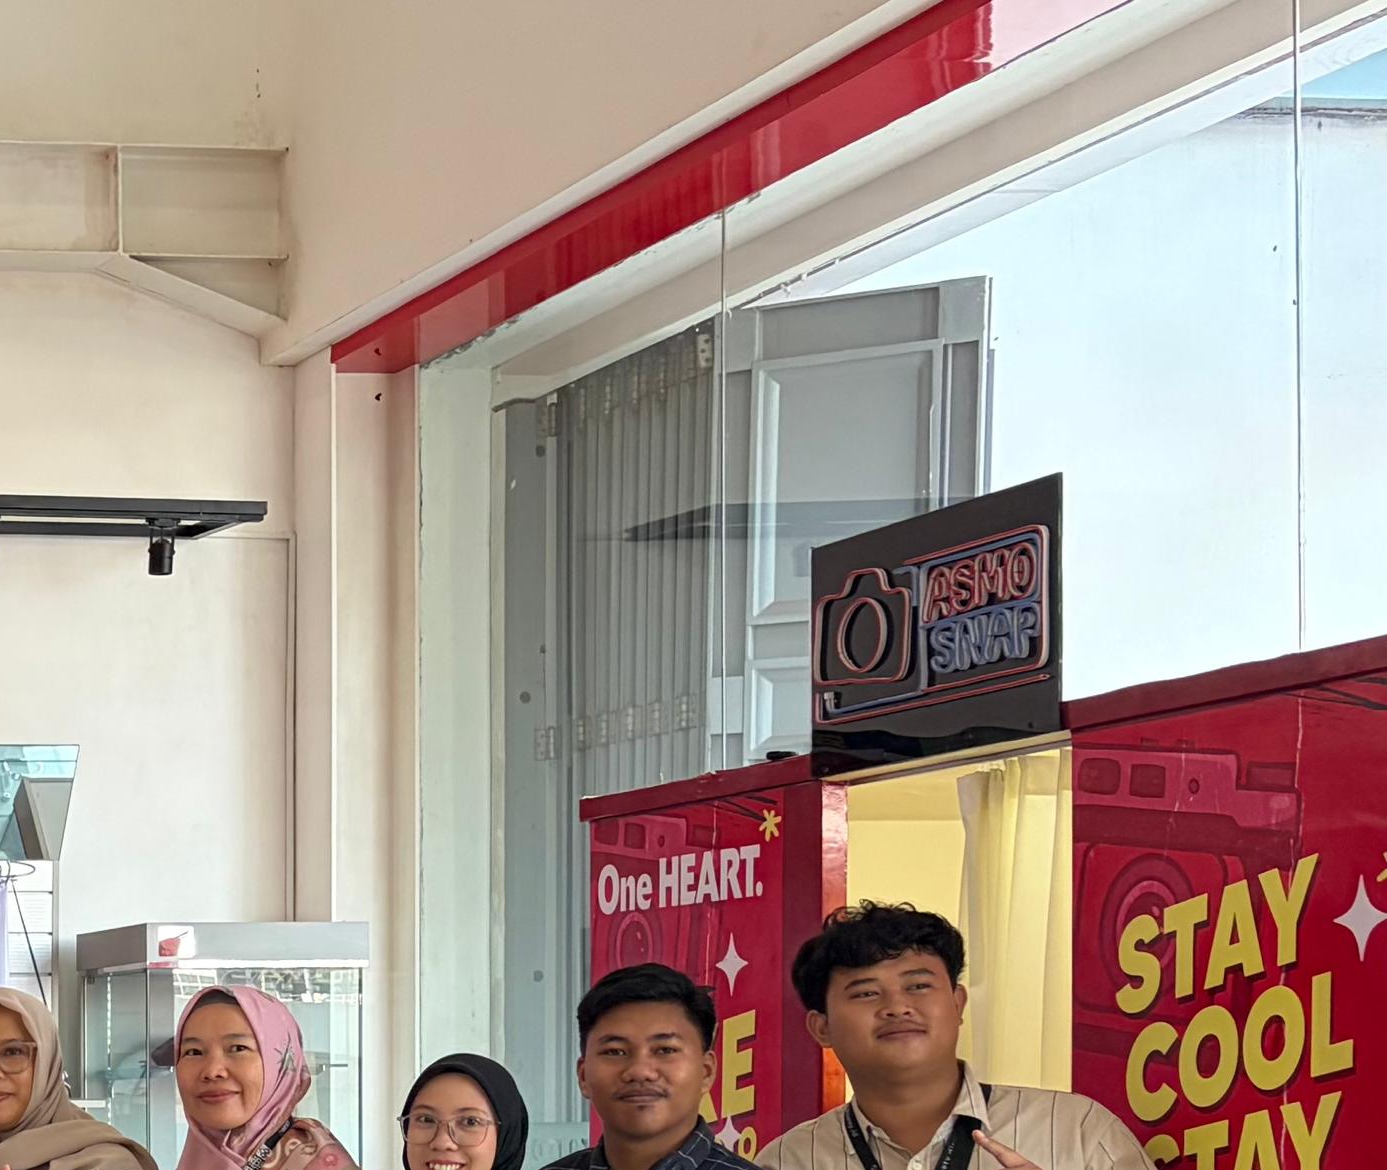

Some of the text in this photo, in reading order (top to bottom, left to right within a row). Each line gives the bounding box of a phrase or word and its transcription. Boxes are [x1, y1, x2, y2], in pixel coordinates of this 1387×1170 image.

[922, 542, 1038, 625] ASMO
[930, 601, 1041, 675] SNAP
[598, 844, 763, 915] One HEART.
[1115, 853, 1319, 1014] STAY
[1126, 971, 1354, 1122] COOL
